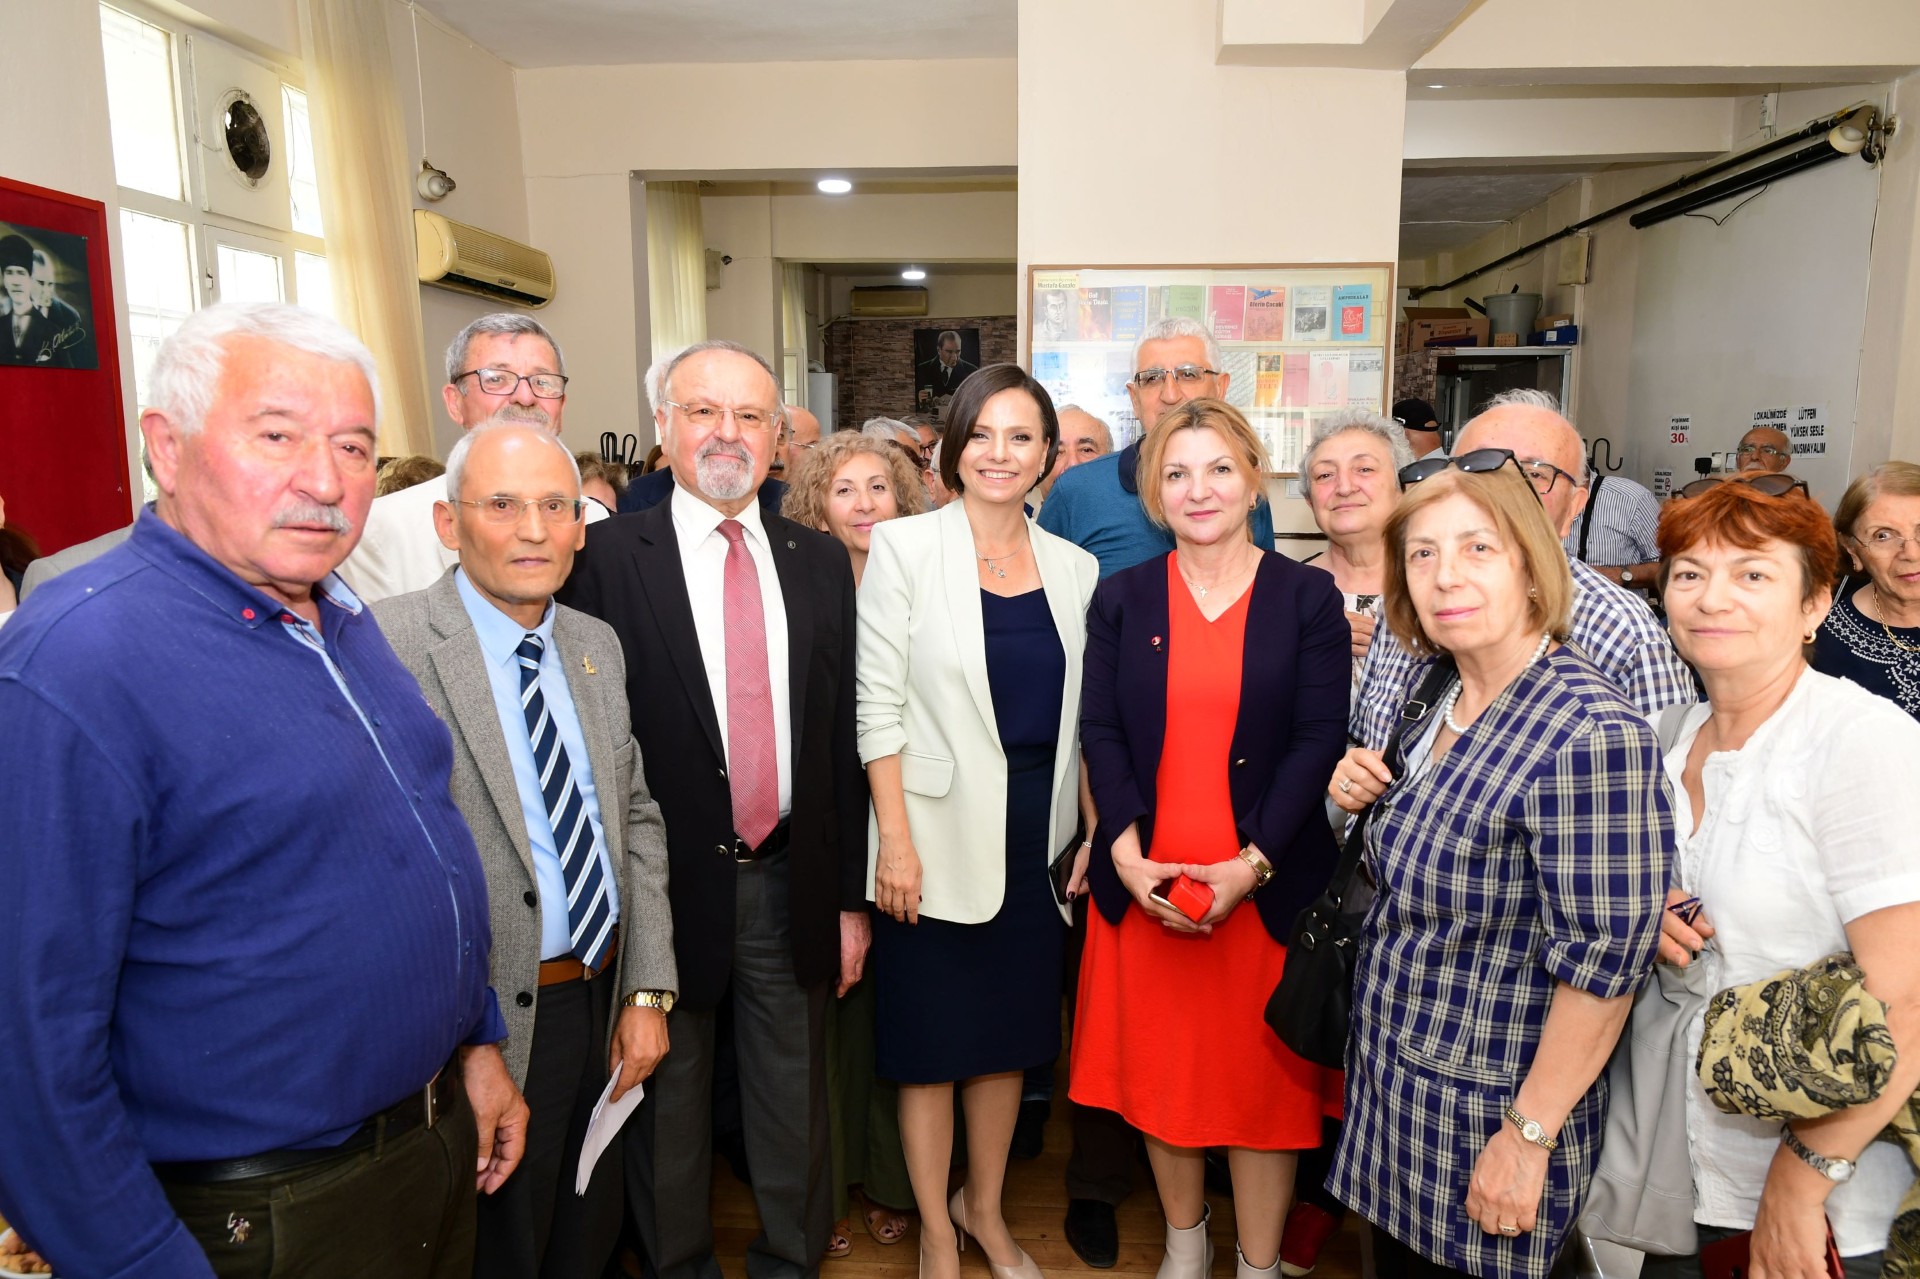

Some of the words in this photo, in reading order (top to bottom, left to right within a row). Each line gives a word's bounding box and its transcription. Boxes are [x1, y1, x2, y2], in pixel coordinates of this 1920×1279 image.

[1798, 406, 1817, 420] LÜTFEN
[1790, 424, 1808, 437] YÜKSEK
[1809, 425, 1824, 436] SESLE
[1670, 432, 1685, 444] 30
[1792, 442, 1826, 457] NUŞMAYALIM
